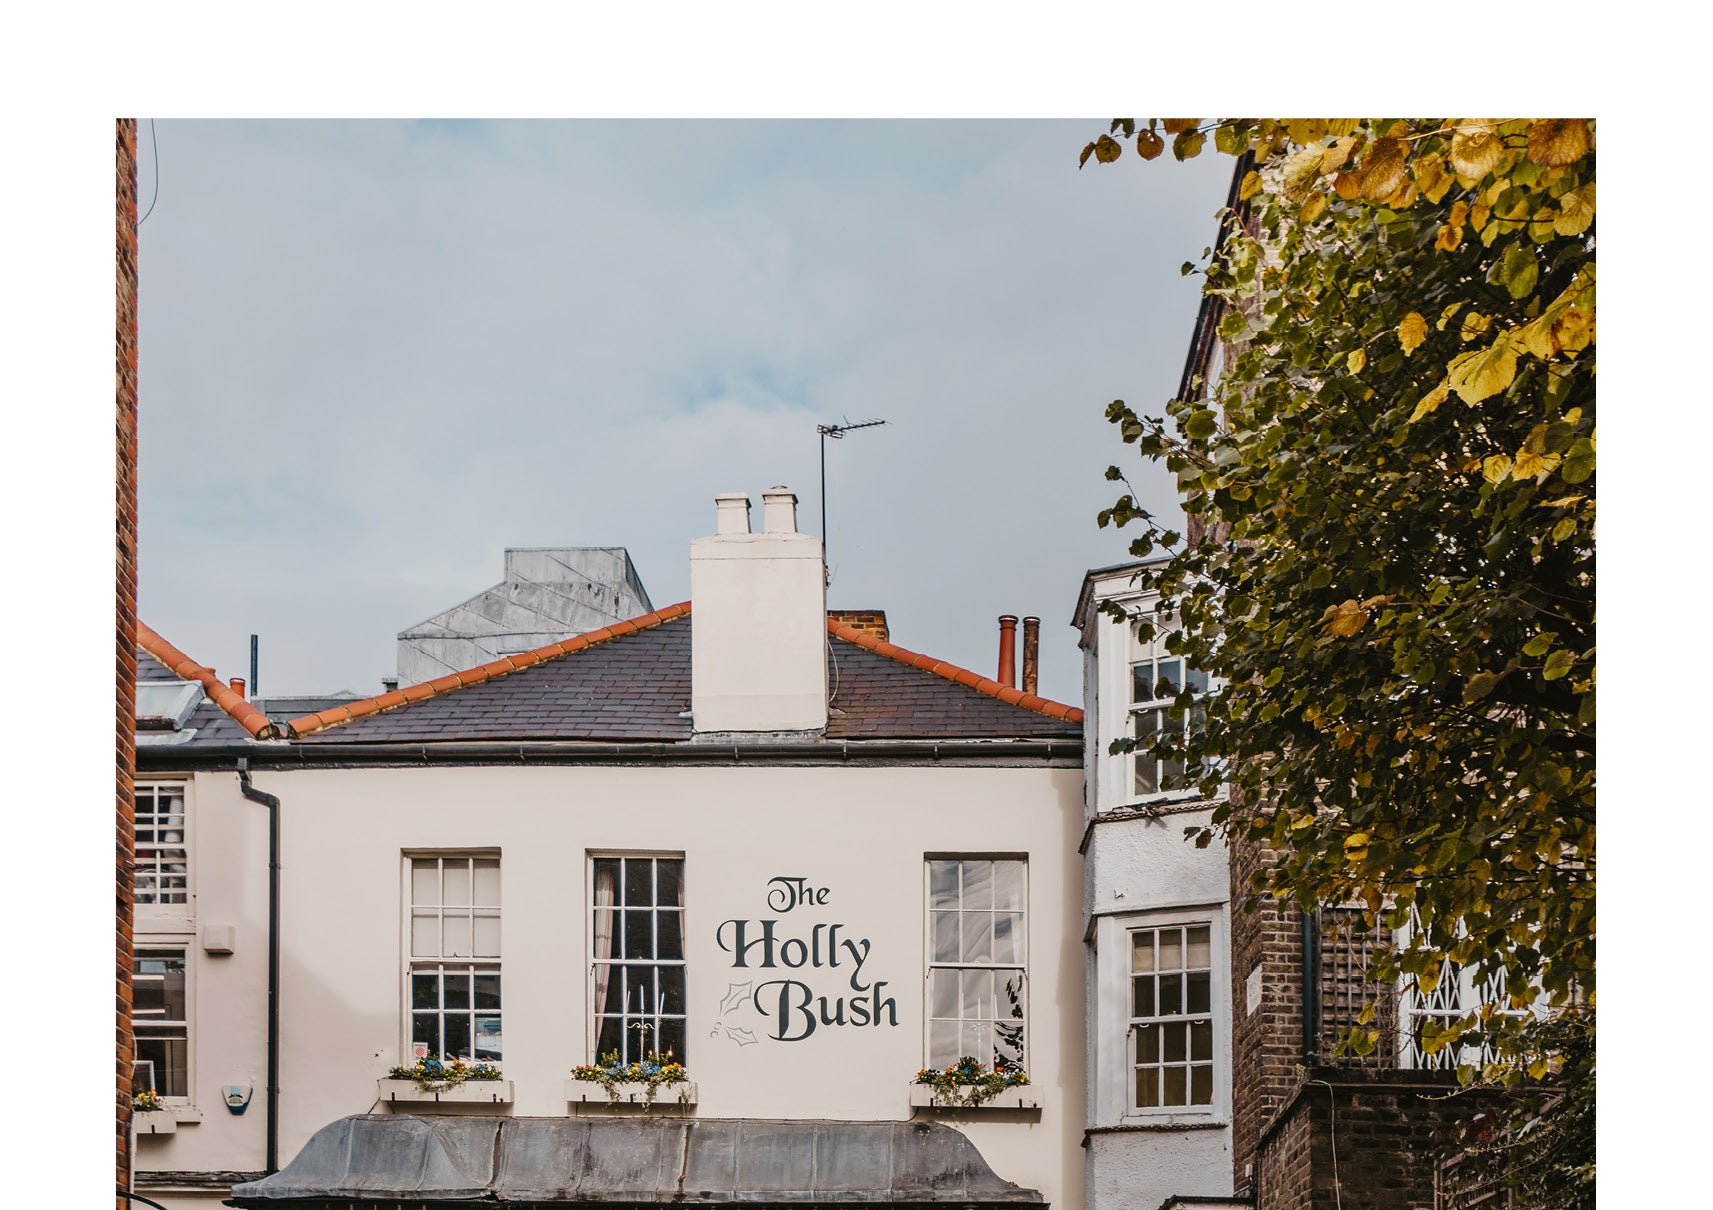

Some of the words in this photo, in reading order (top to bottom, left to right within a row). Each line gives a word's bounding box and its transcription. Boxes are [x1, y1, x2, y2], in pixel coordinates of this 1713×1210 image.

[767, 876, 831, 913] The
[716, 919, 871, 992] Holly
[753, 979, 900, 1042] Bush
